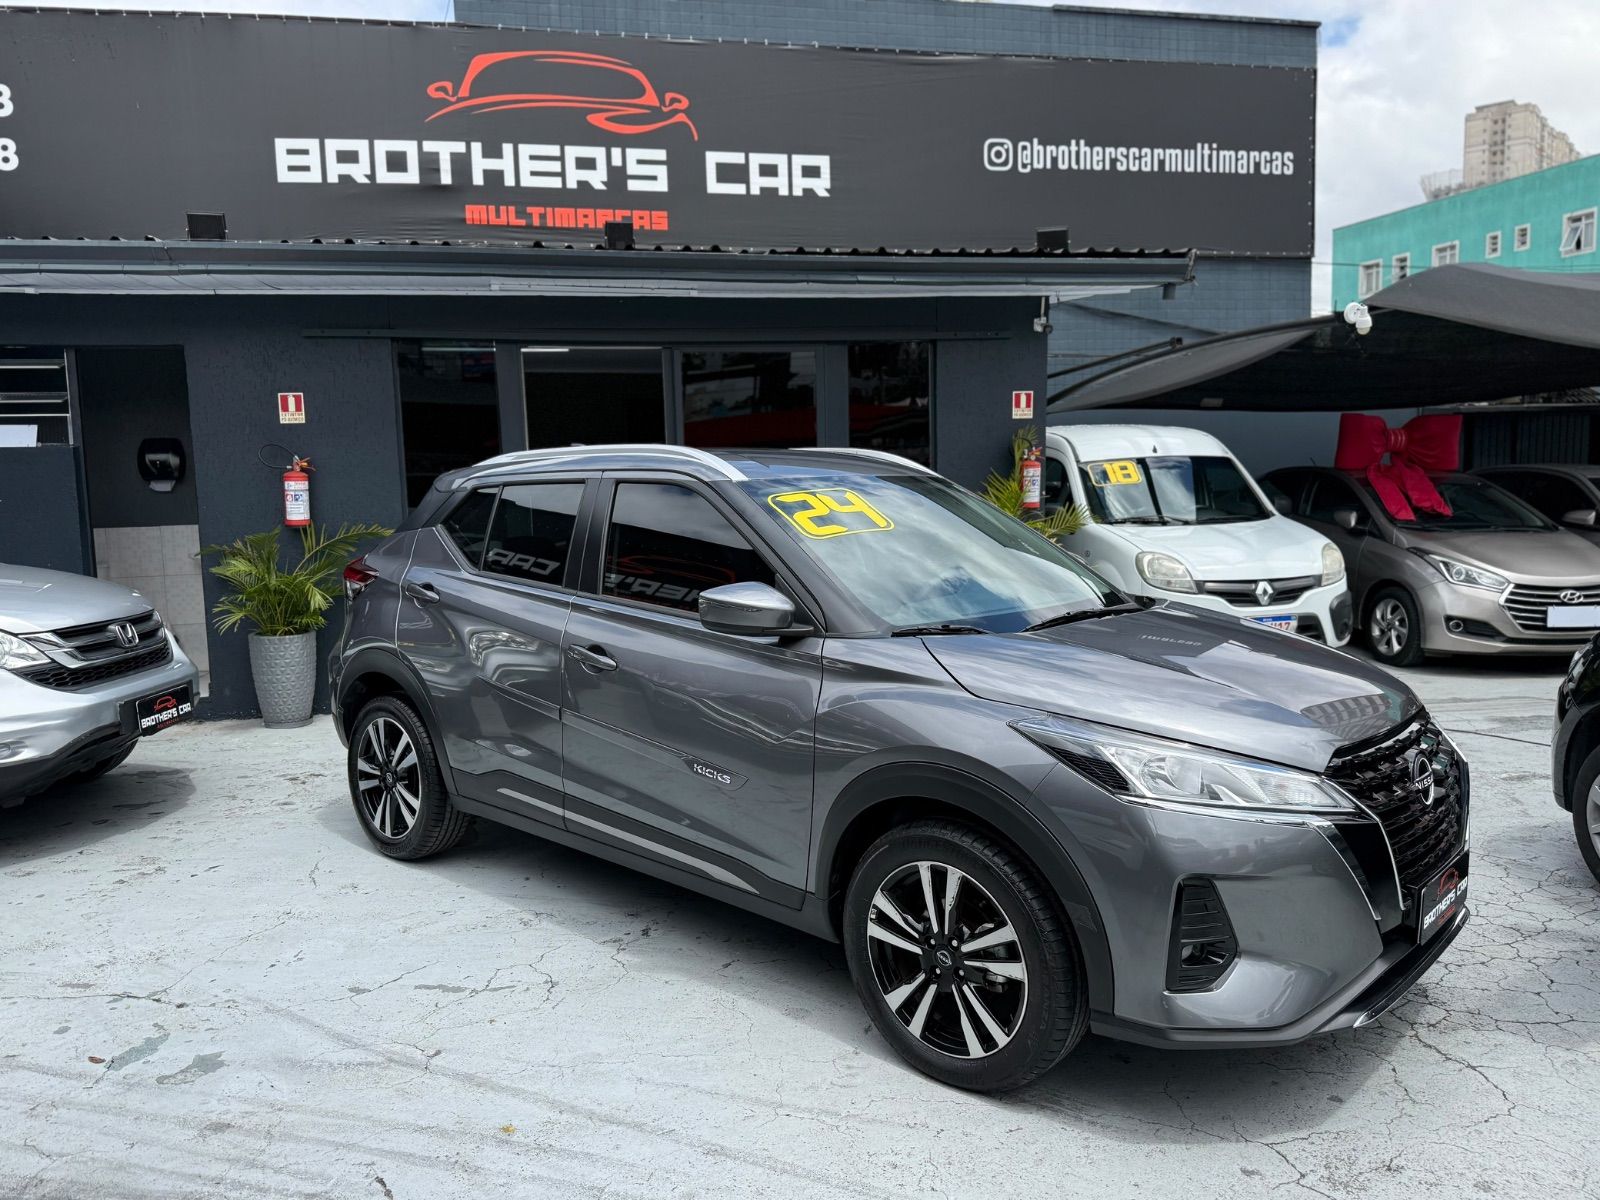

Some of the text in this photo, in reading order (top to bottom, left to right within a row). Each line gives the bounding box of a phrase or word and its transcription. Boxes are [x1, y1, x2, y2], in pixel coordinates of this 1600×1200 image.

[0, 137, 19, 171] 8
[274, 138, 831, 197] BROTHER'S CAR
[1018, 138, 1294, 175] @brotherscarmultimarcas
[1103, 461, 1139, 485] 18
[775, 490, 888, 536] 24
[140, 708, 177, 729] BROTHER'S
[178, 702, 192, 715] CAR
[693, 763, 731, 784] KICKS
